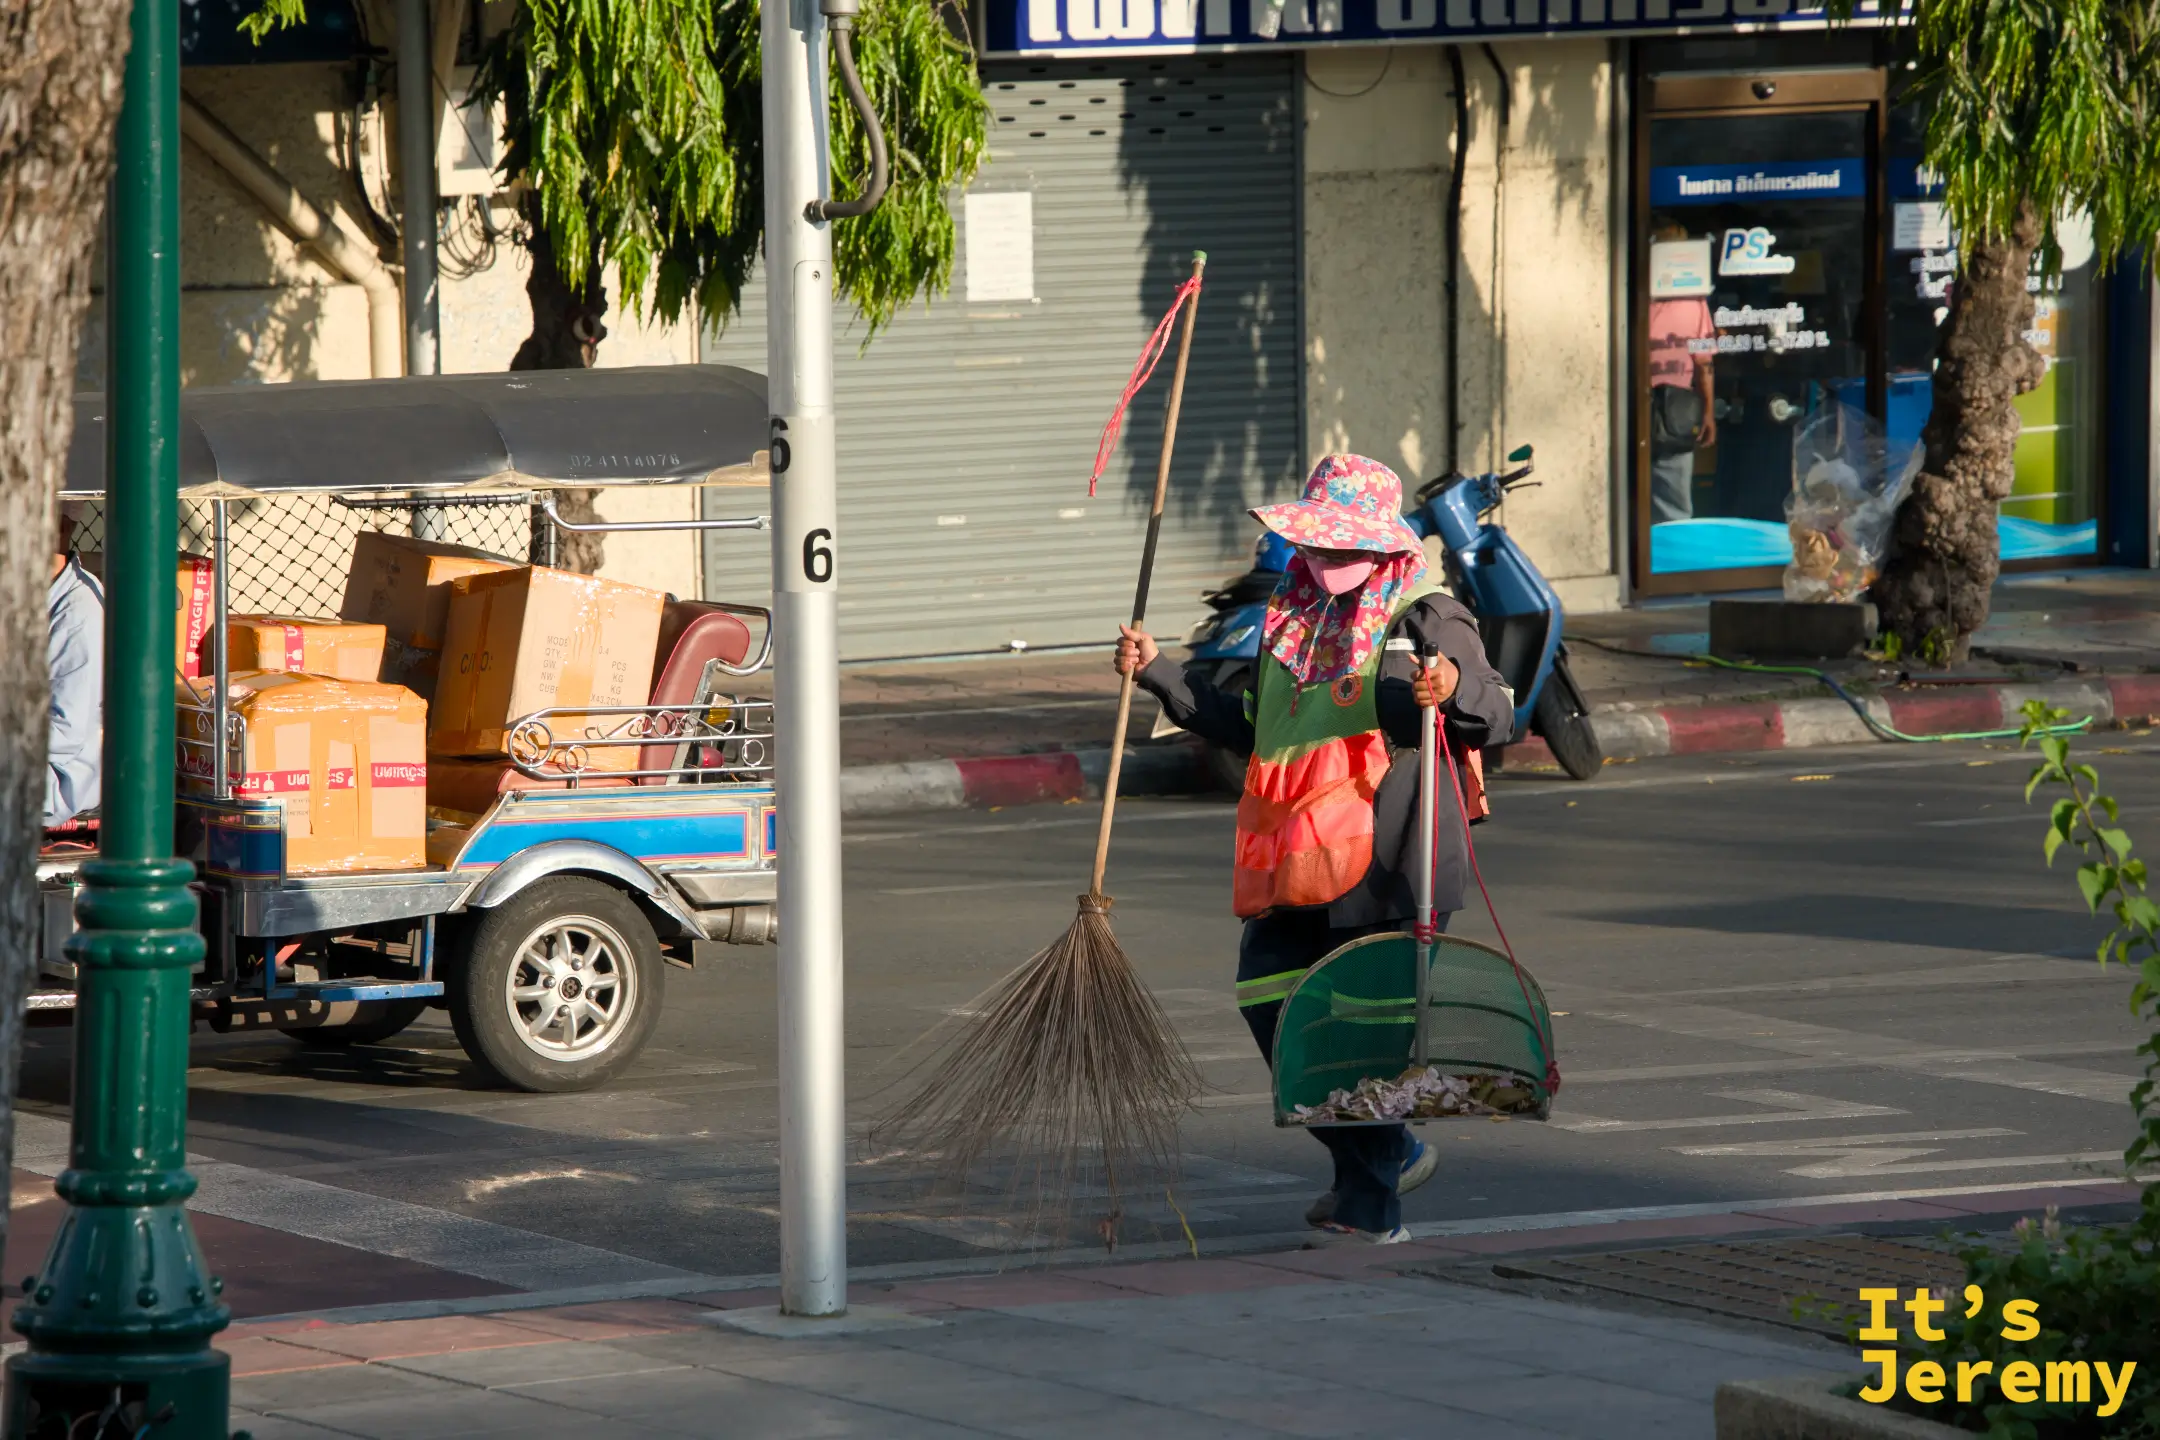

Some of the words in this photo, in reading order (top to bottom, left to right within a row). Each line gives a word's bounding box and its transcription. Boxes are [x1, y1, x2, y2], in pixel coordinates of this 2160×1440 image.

[1725, 231, 1767, 260] PS
[770, 417, 791, 474] 6
[803, 527, 833, 583] 6
[611, 660, 627, 672] PCS
[612, 672, 624, 683] KG
[610, 684, 621, 695] KG
